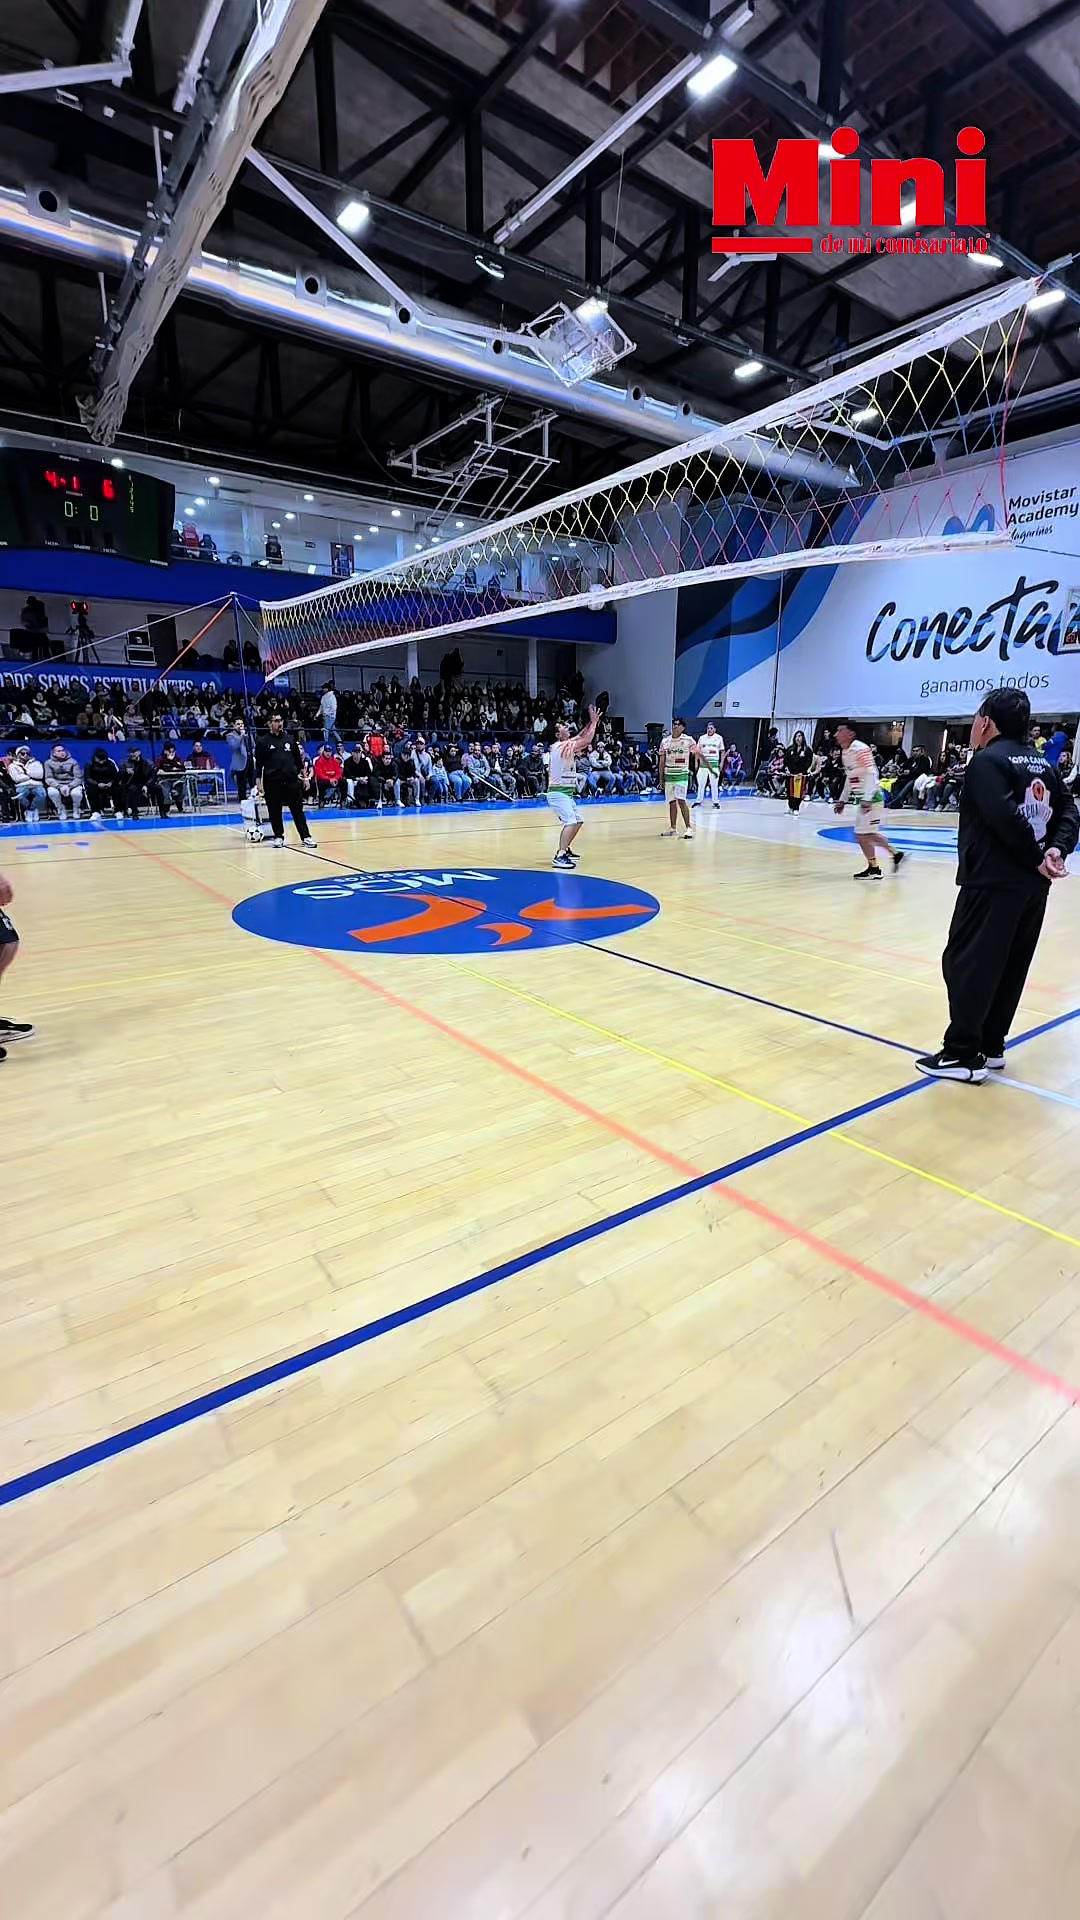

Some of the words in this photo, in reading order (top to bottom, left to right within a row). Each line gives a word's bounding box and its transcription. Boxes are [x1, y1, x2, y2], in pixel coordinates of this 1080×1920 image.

[1008, 486, 1078, 512] Movistar
[1008, 502, 1080, 526] Academy
[920, 677, 994, 698] ganamos
[999, 671, 1049, 689] todos
